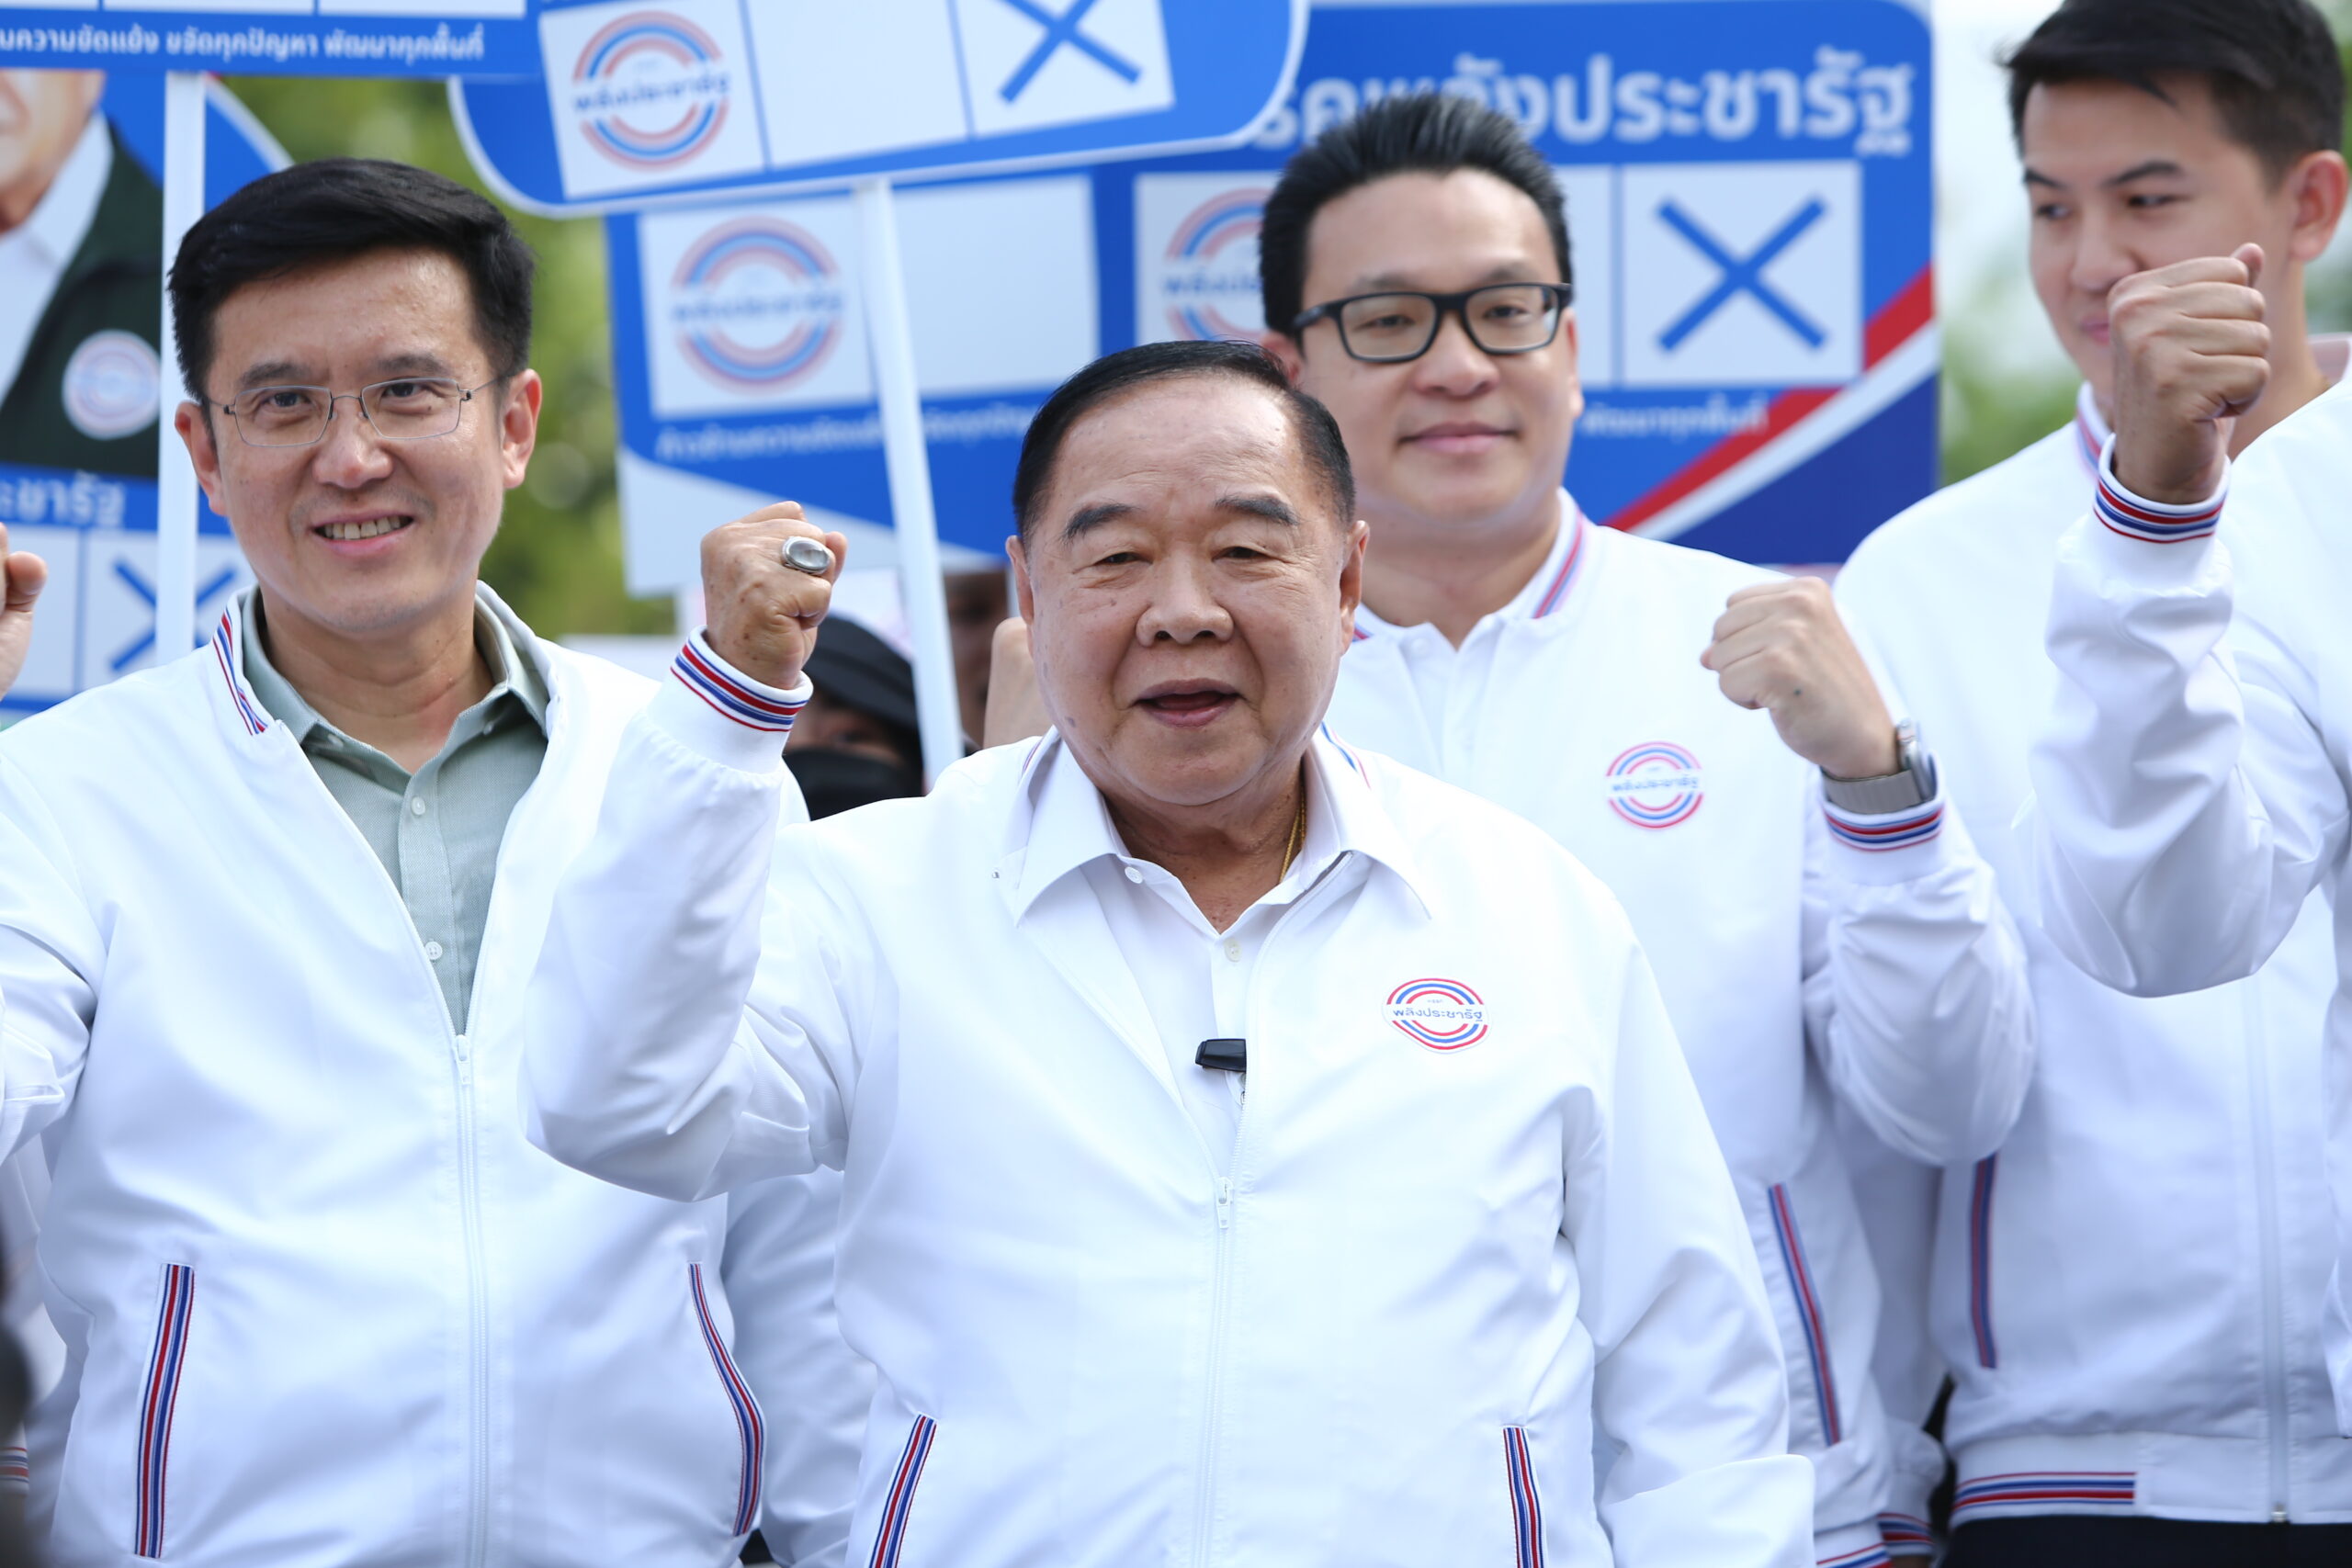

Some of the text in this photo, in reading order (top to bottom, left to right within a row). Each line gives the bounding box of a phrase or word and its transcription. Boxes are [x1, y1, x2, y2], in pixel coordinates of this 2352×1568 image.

[165, 25, 319, 62] ขจัดทุกปัญหา
[1392, 1007, 1484, 1022] พลังประชารัฐ
